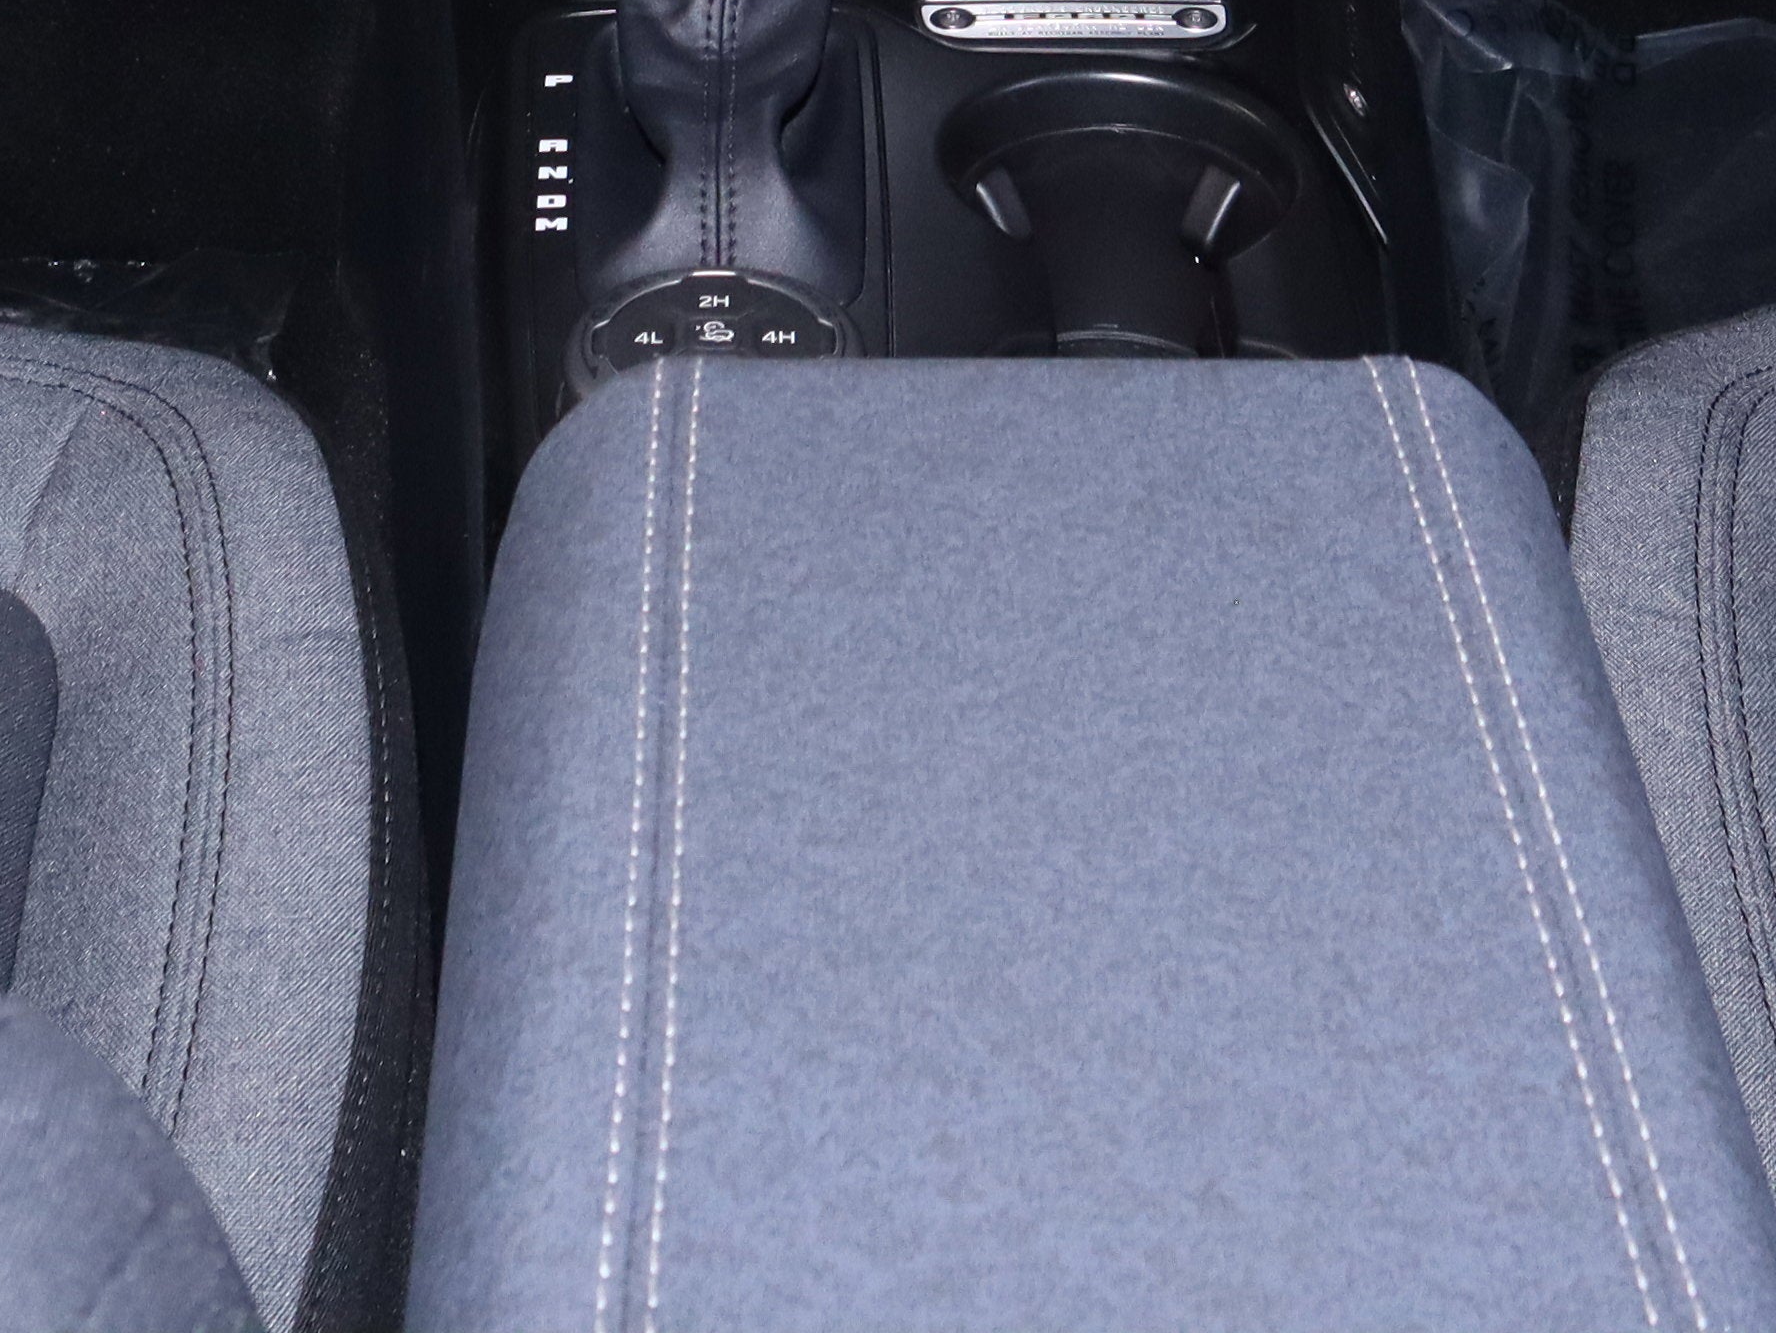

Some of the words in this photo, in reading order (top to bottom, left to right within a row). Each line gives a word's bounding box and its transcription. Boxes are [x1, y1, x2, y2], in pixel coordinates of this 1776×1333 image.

[544, 74, 574, 87] P
[538, 165, 568, 180] N
[536, 194, 567, 209] D
[534, 216, 568, 232] M
[698, 294, 730, 309] 2H
[634, 331, 664, 345] 4L
[761, 330, 796, 345] 4H
